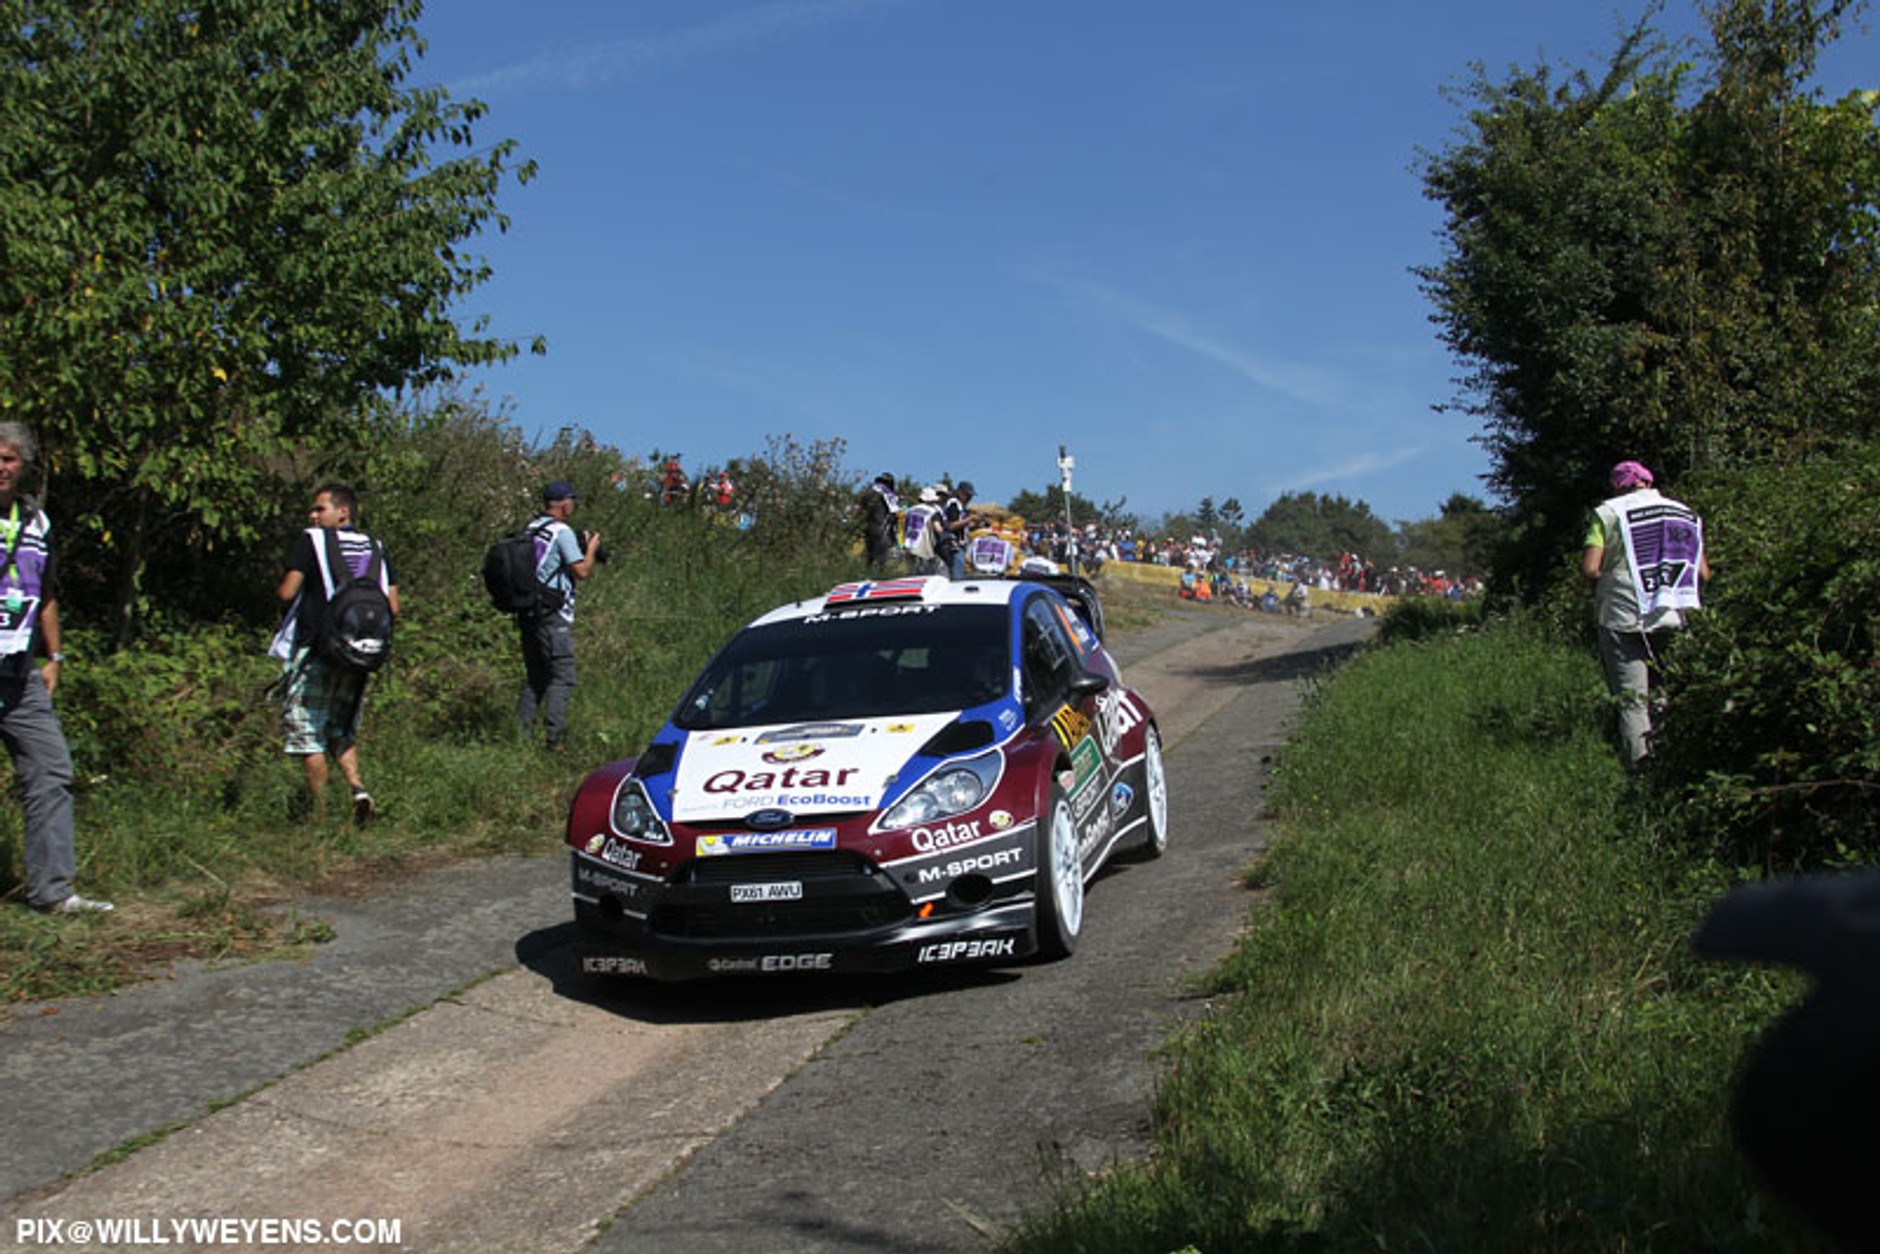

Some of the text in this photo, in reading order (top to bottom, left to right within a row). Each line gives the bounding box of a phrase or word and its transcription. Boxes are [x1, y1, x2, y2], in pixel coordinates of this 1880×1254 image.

[803, 604, 941, 624] M-SPORT
[703, 767, 860, 795] Qatar
[777, 793, 871, 806] EcoBoost
[731, 831, 832, 847] MICHELIN
[911, 820, 981, 851] Qatar
[601, 838, 642, 870] Qatar
[918, 848, 1023, 883] M-SPORT
[733, 885, 800, 899] PX61 AWU
[761, 953, 833, 971] EDGE
